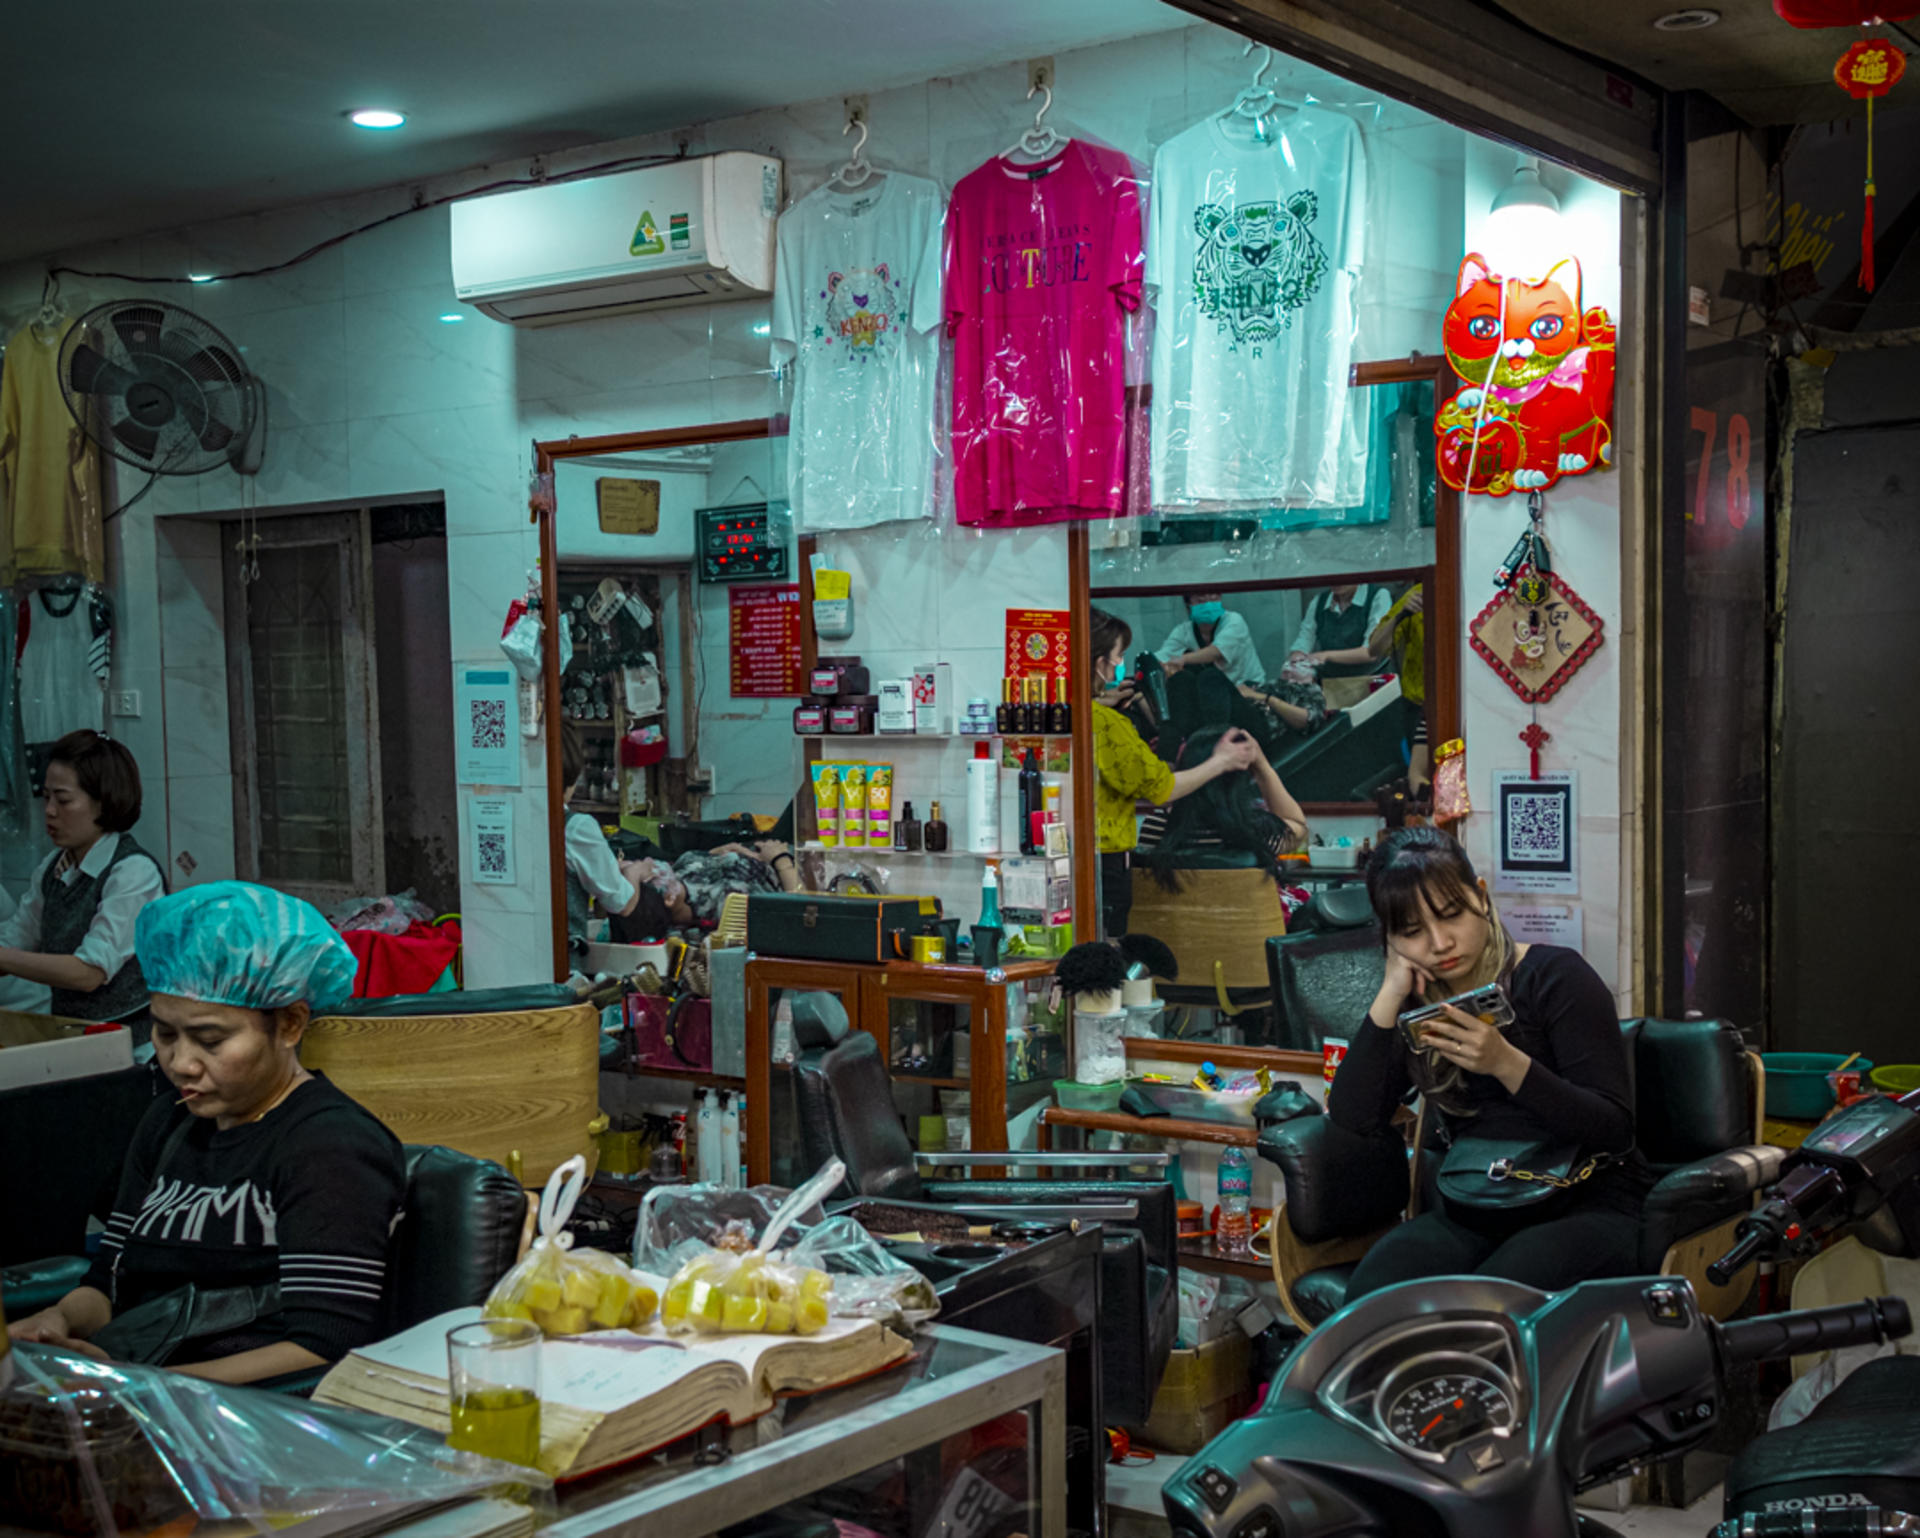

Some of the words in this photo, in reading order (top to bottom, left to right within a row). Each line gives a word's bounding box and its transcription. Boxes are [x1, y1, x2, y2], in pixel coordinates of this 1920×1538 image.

[1208, 279, 1300, 312] KENZO
[1690, 406, 1751, 530] 78
[871, 787, 887, 800] 50
[1764, 1493, 1872, 1513] HONDA
